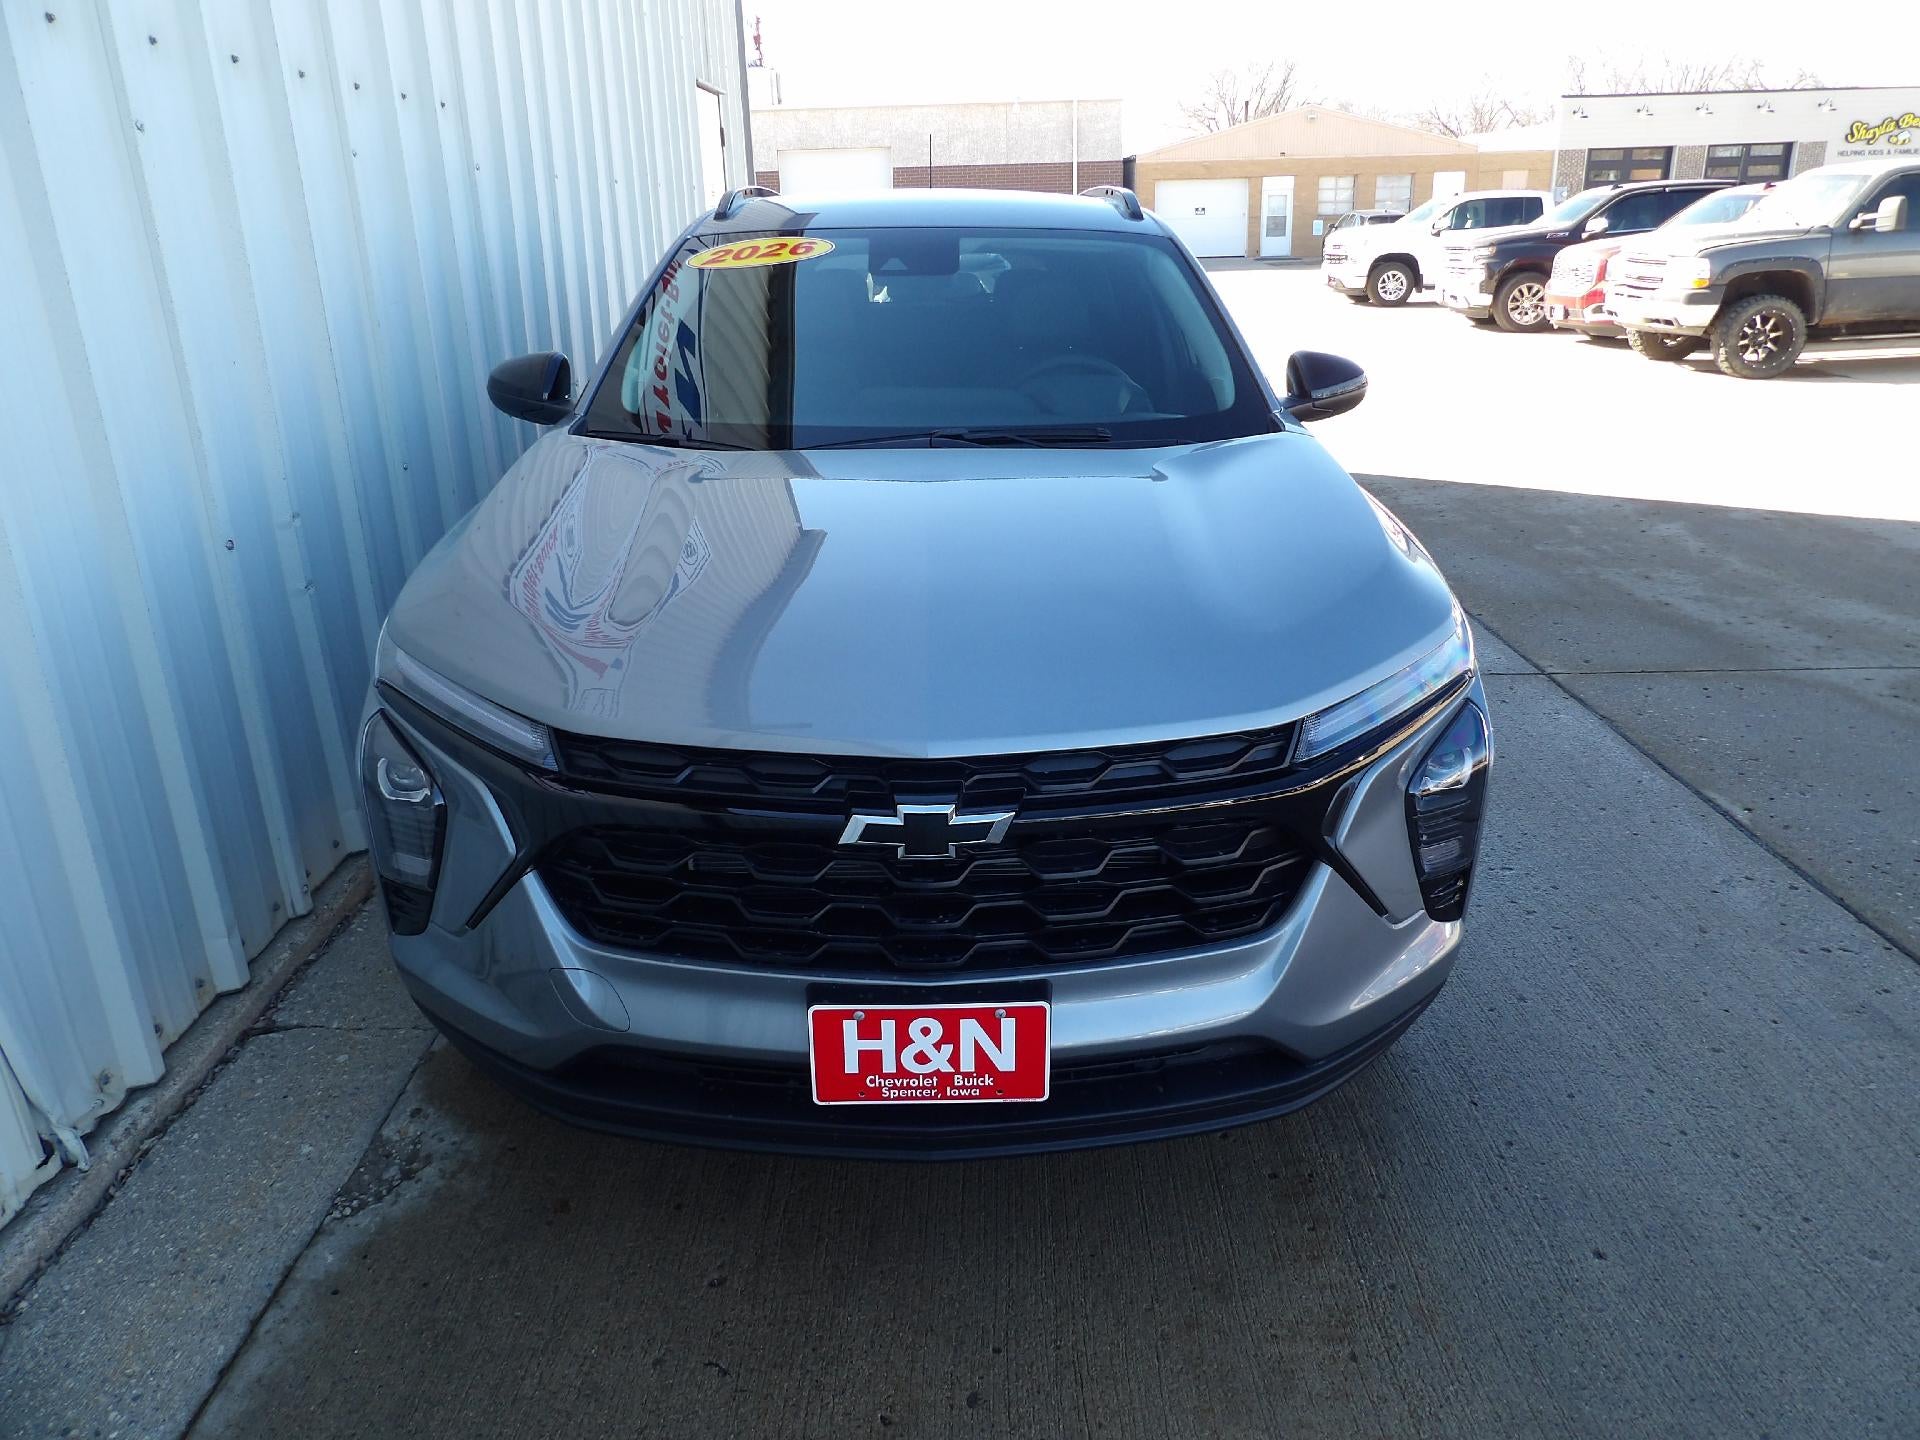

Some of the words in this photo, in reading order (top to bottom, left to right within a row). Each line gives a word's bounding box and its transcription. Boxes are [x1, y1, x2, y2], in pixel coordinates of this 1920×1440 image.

[1845, 117, 1896, 145] Shayla
[700, 241, 817, 265] 2026
[842, 1017, 1016, 1074] H&N
[866, 1075, 938, 1088] Chevrolet
[953, 1073, 994, 1087] Buick
[881, 1086, 942, 1099] Spencer,
[946, 1086, 980, 1097] Iowa
